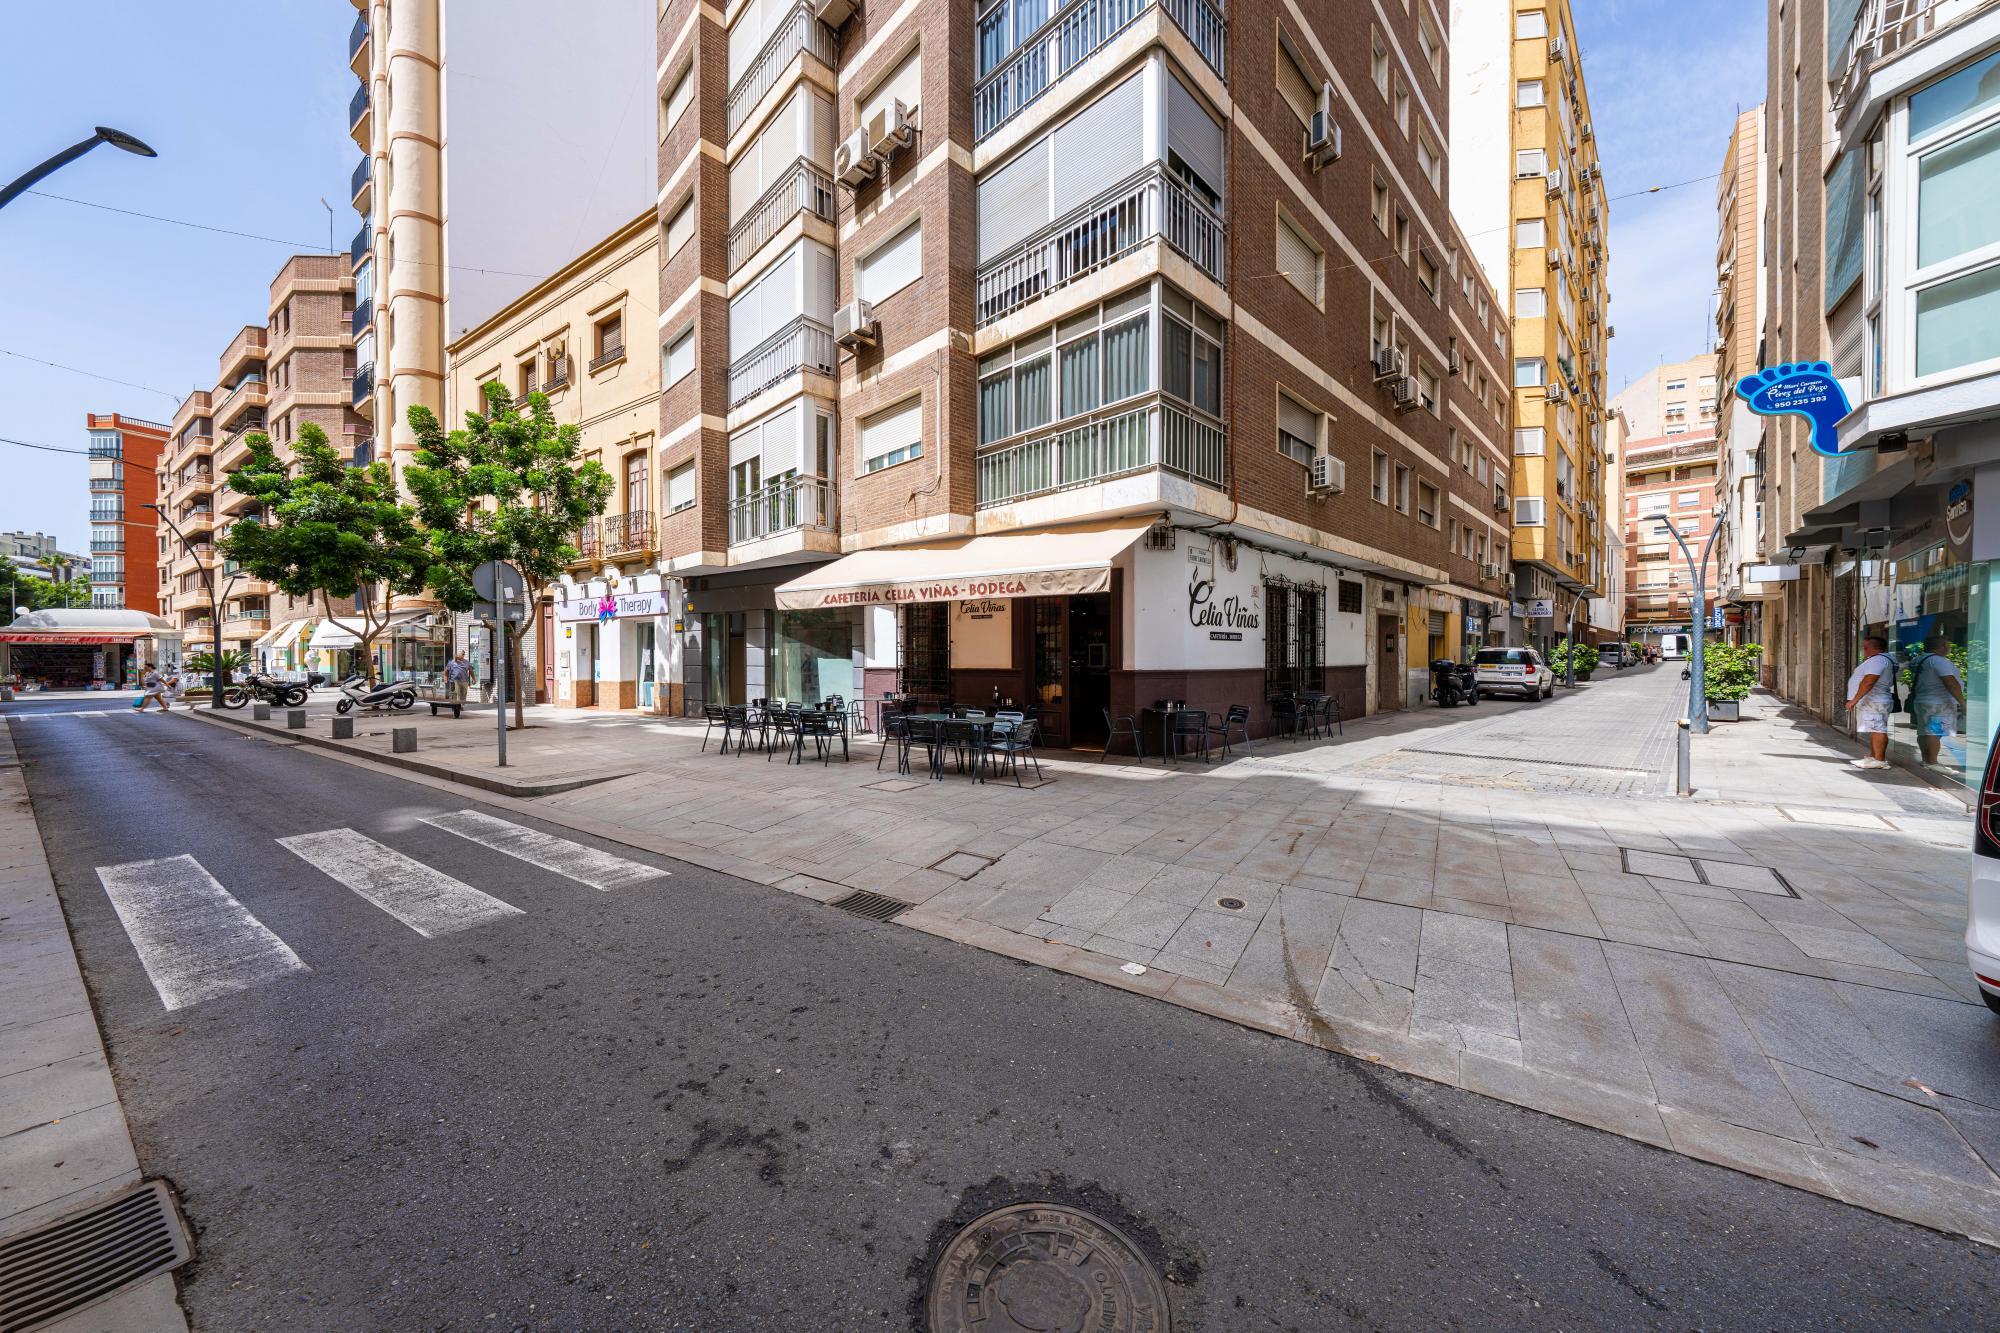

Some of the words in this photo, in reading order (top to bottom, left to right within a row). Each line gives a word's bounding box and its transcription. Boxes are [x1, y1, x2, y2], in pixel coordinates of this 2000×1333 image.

[1793, 386, 1806, 395] del
[824, 586, 880, 605] CAFETERÍA
[885, 588, 916, 601] CELIA
[919, 583, 959, 600] VIÑAS
[969, 580, 1027, 597] BODEGA
[579, 600, 598, 617] Body
[619, 597, 652, 614] Therapy
[980, 600, 1007, 614] Viñas
[1188, 580, 1223, 627] Celia
[1224, 595, 1260, 629] Viñas
